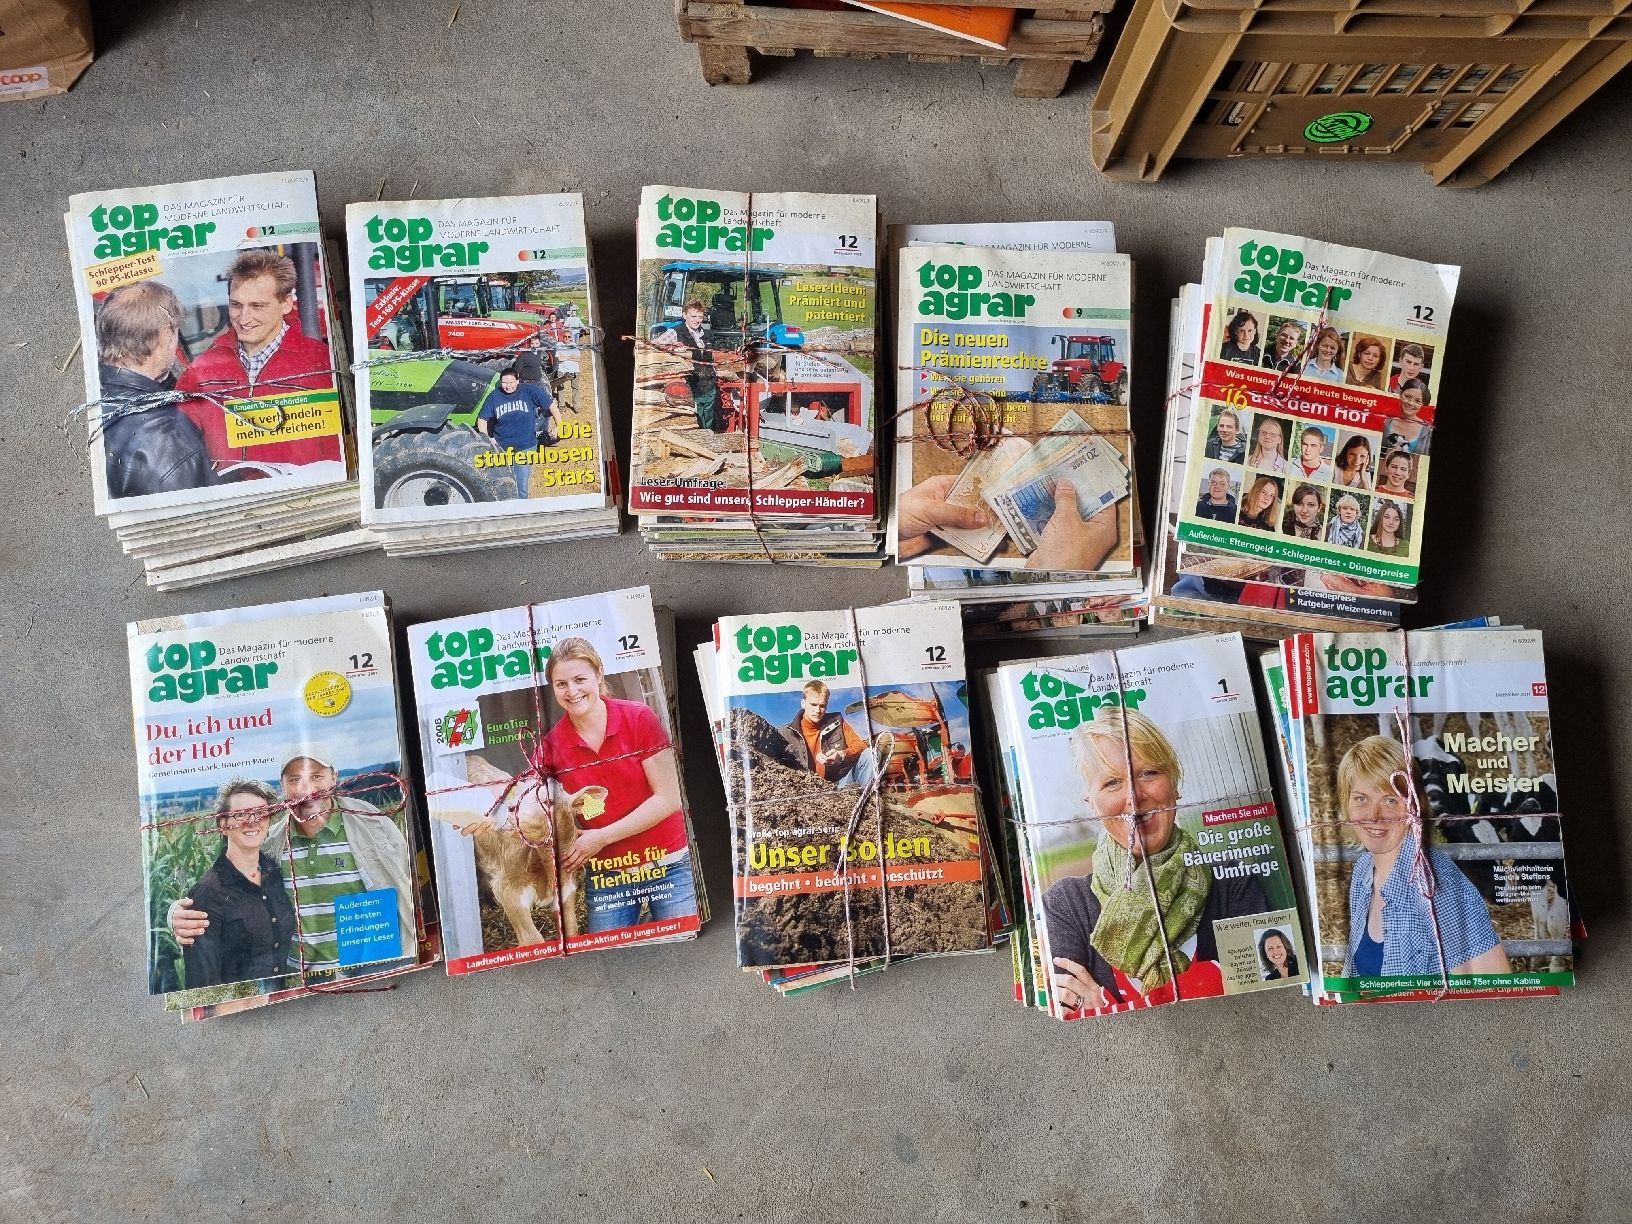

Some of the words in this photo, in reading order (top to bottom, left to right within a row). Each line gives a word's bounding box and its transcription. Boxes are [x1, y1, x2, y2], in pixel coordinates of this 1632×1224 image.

[164, 203, 182, 212] DAS
[185, 198, 226, 210] MAGAZIN
[211, 202, 290, 217] LANDWIRTSCHAFT
[656, 194, 721, 224] top
[723, 208, 738, 216] Das
[776, 209, 788, 218] für
[790, 210, 826, 219] moderne
[88, 203, 159, 232] top
[262, 226, 275, 235] 12
[364, 215, 433, 244] top
[656, 223, 774, 253] agrar
[94, 221, 216, 259] agrar
[838, 235, 858, 248] 12
[1033, 242, 1049, 250] FÜR
[1051, 241, 1091, 249] MODERNE
[368, 241, 489, 272] agrar
[533, 250, 546, 259] 12
[1237, 239, 1304, 275] top
[88, 254, 156, 279] Schlepper-Test
[96, 277, 108, 287] 90
[110, 266, 154, 284] PS-Klasse
[916, 260, 982, 291] top
[987, 270, 1004, 278] DAS
[1006, 271, 1045, 281] MAGAZIN
[1048, 272, 1064, 281] FÜR
[1066, 273, 1107, 282] MODERNE
[1304, 261, 1320, 272] Das
[1321, 264, 1356, 278] Magazin
[1358, 270, 1370, 280] für
[1371, 274, 1406, 288] moderne
[796, 282, 867, 296] Leser-Ideen:
[987, 281, 1061, 291] LANDWIRTSCHAFT
[1233, 269, 1352, 311] agrar
[1302, 272, 1362, 289] Landwirtschaft
[370, 313, 385, 329] Test
[382, 301, 394, 316] 160
[392, 278, 420, 306] PS-Klasse
[789, 295, 843, 307] Prämiert
[845, 298, 866, 309] und
[917, 290, 1035, 320] agrar
[806, 310, 866, 323] patentiert
[1076, 308, 1082, 317] 9
[1412, 305, 1434, 322] 12
[920, 328, 951, 346] Die
[955, 333, 1008, 348] neuen
[920, 350, 1048, 371] Prämienrechte
[969, 375, 1005, 385] gehören
[1225, 369, 1245, 379] Was
[1247, 375, 1275, 386] unsere
[1313, 387, 1340, 398] heute
[1342, 392, 1377, 407] bewegt
[931, 402, 947, 410] Wie
[1221, 383, 1248, 410] 16
[1288, 395, 1328, 417] dem
[237, 430, 265, 440] mehr
[557, 420, 592, 440] Die
[474, 445, 593, 468] stufenlosen
[543, 468, 595, 487] Stars
[641, 477, 727, 491] Leser-Umfrage:
[640, 491, 661, 503] Wie
[664, 492, 685, 506] gut
[687, 491, 710, 504] sind
[715, 493, 751, 506] unsere
[756, 495, 865, 510] Schlepper-Händler?
[1188, 529, 1227, 545] Außerdem:
[1229, 538, 1274, 554] Elterngeld
[1282, 548, 1341, 567] Schleppertest
[1348, 561, 1410, 579] Düngerpreise
[1297, 587, 1357, 603] Getreidepreise
[1297, 598, 1335, 610] Ratgeber
[1336, 603, 1393, 617] Weizensorten
[496, 632, 511, 642] Das
[550, 623, 563, 633] für
[733, 624, 801, 654] top
[804, 632, 820, 641] Das
[873, 627, 911, 636] moderne
[219, 645, 236, 655] Das
[237, 641, 276, 654] Magazin
[278, 639, 291, 650] für
[425, 627, 494, 662] top
[617, 635, 640, 651] 12
[146, 639, 217, 673] top
[349, 653, 374, 669] 12
[925, 646, 947, 662] 12
[1324, 643, 1387, 675] top
[430, 645, 551, 690] agrar
[737, 650, 858, 685] agrar
[1143, 667, 1156, 677] für
[1158, 662, 1195, 673] moderne
[149, 661, 278, 703] agrar
[1217, 678, 1229, 694] 1
[1326, 674, 1434, 707] agrar
[1533, 685, 1545, 694] 12
[146, 722, 182, 741] Du,
[187, 716, 221, 736] ich
[227, 708, 273, 731] und
[435, 717, 444, 744] 2008
[487, 718, 529, 733] EuroTier
[148, 747, 186, 765] der
[191, 736, 234, 759] Hof
[1443, 732, 1540, 752] Macher
[1477, 756, 1508, 769] und
[1446, 773, 1543, 793] Meister
[1205, 810, 1237, 823] Machen
[1239, 809, 1251, 818] Sie
[1253, 806, 1269, 816] mit!
[775, 828, 790, 837] top
[1197, 830, 1224, 846] Die
[1227, 822, 1272, 844] große
[588, 851, 641, 872] Trends
[644, 846, 668, 863] für
[749, 843, 831, 870] Unser
[1183, 843, 1275, 867] Bäuerinnen-
[591, 864, 668, 890] Tierhalter
[1212, 859, 1279, 880] Umfrage
[593, 893, 624, 903] Kompakt
[632, 883, 675, 895] übersichtlich
[749, 877, 801, 895] begehrt
[595, 903, 607, 912] auf
[607, 901, 625, 909] mehr
[626, 899, 637, 907] als
[637, 895, 650, 903] 100
[651, 892, 672, 902] Seiten
[355, 911, 381, 920] besten
[341, 922, 390, 934] Erfindungen
[1216, 923, 1229, 931] Wie
[341, 937, 371, 947] unserer
[374, 933, 394, 942] Leser
[466, 952, 514, 969] Landtechnik
[515, 950, 533, 961] live:
[534, 945, 557, 957] Große
[621, 931, 632, 940] für
[633, 928, 656, 939] junge
[1359, 979, 1414, 989] Schleppertest:
[1513, 977, 1541, 985] Kabine
